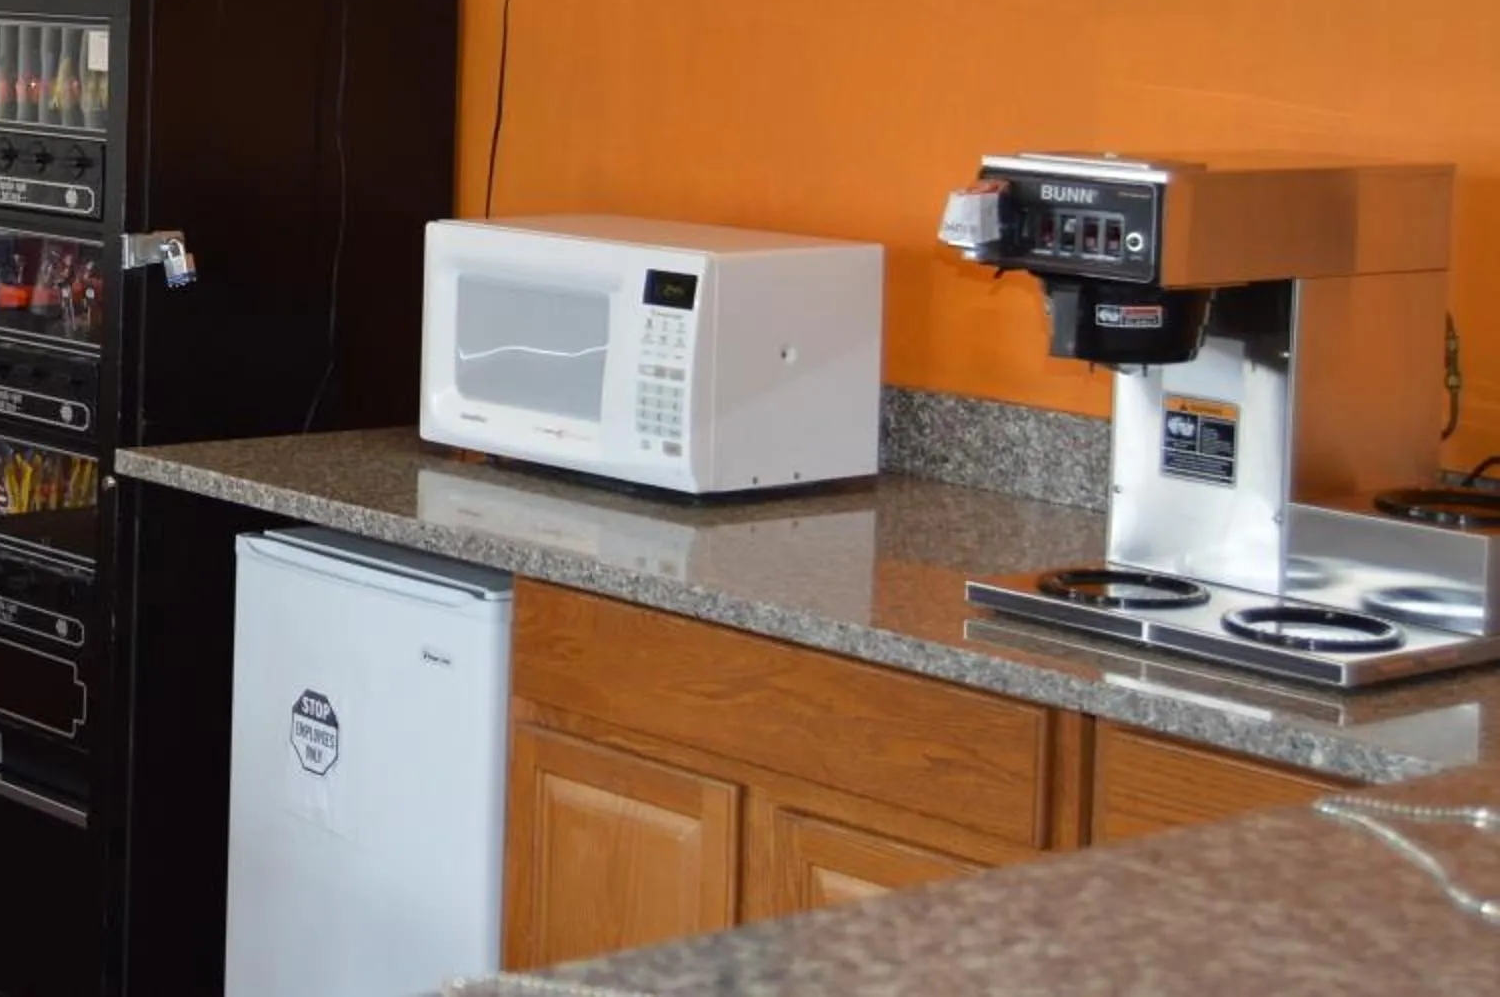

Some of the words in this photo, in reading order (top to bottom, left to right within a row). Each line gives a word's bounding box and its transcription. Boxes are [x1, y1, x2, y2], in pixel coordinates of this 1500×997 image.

[1040, 184, 1094, 203] BUNN
[301, 696, 330, 720] STOP
[295, 720, 335, 749] EMPLOYEES
